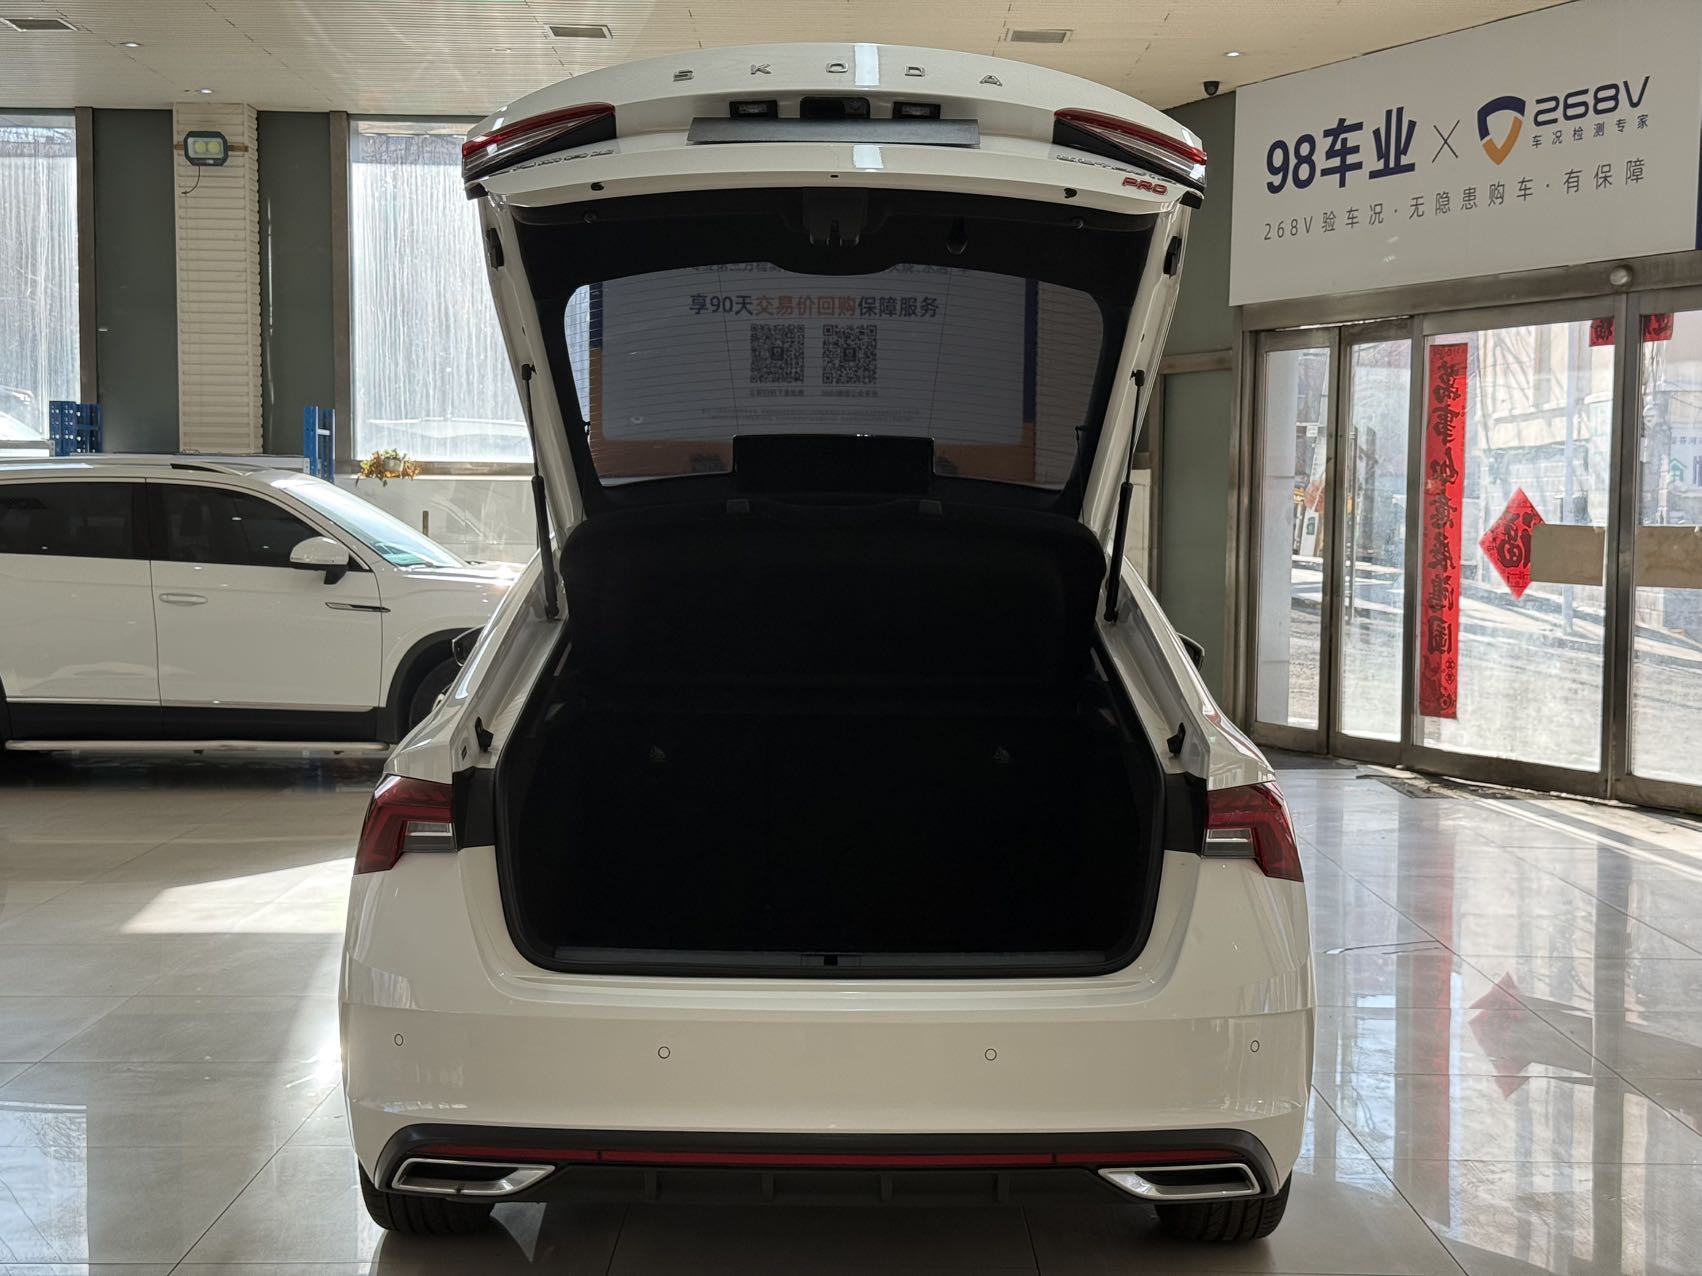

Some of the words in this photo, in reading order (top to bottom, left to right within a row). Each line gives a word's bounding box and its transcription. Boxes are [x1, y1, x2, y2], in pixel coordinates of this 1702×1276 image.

[673, 62, 1003, 87] SKODA
[1266, 106, 1417, 194] 98车业
[1533, 75, 1651, 128] 268V
[1532, 113, 1649, 149] 车况检测专家
[1121, 176, 1169, 196] PRO
[688, 295, 940, 319] 享90天交易价回购保障服务
